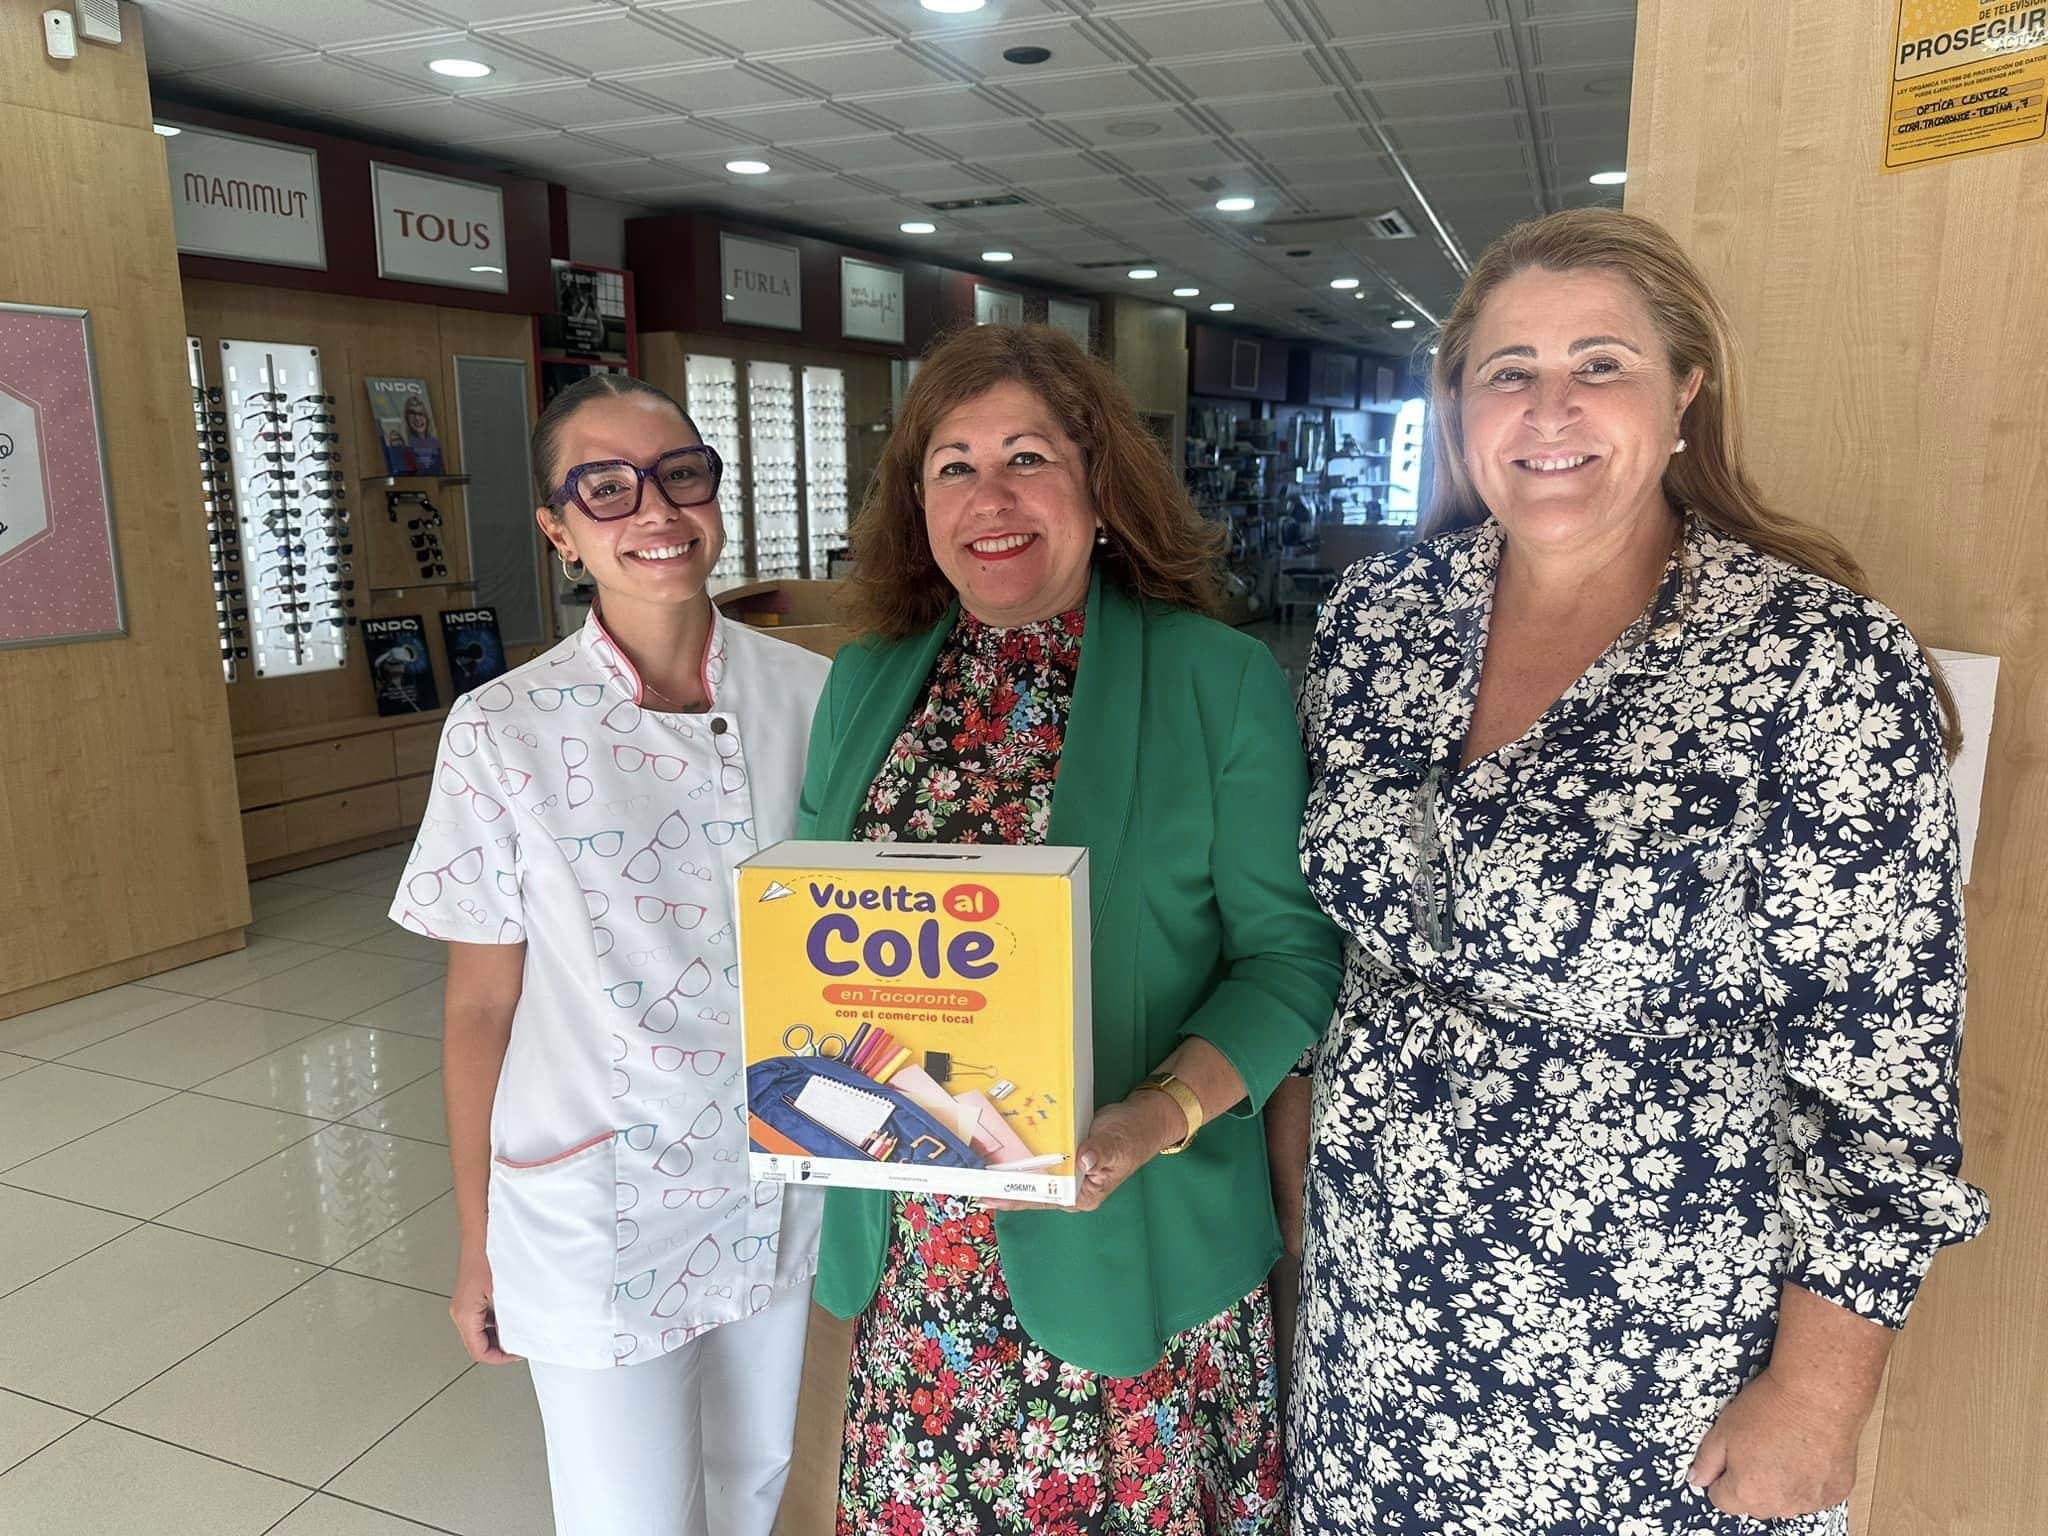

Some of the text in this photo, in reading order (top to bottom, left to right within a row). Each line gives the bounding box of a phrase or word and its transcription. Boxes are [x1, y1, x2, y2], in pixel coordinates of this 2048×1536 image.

[1979, 9, 1991, 20] DE
[1899, 8, 2046, 64] PROSEGUR
[1897, 87, 1908, 95] LEY
[1961, 87, 2008, 105] CENTER
[184, 173, 308, 218] MAMMUT
[393, 208, 490, 250] TOUS
[734, 269, 792, 296] FURLA
[374, 382, 422, 394] INDO
[367, 619, 418, 633] INDO
[445, 611, 493, 624] INDO
[809, 882, 983, 913] Vuelta al
[806, 913, 999, 979] Cole
[840, 989, 969, 1006] en Tacoronte
[835, 1009, 974, 1025] con el comercio local
